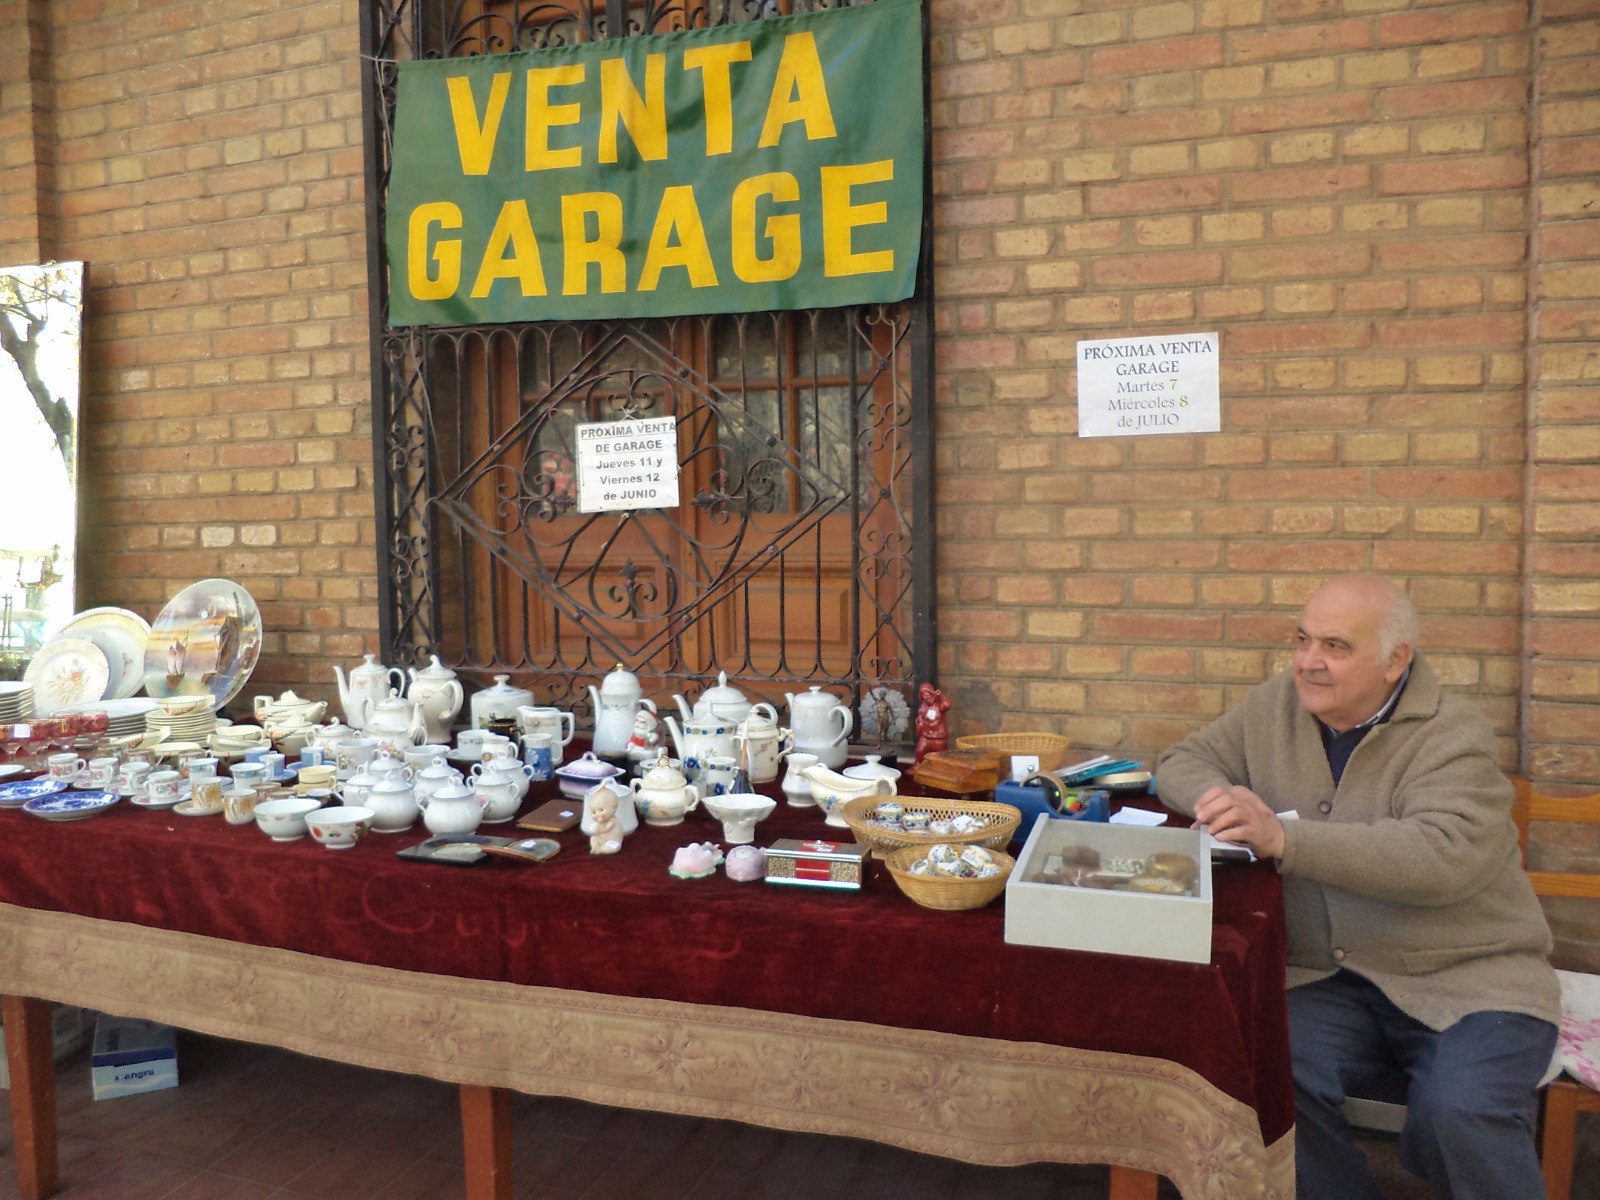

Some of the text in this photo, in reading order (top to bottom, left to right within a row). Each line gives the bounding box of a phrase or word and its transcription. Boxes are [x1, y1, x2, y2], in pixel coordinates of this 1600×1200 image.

[447, 31, 837, 176] VENTA
[408, 159, 894, 300] GARAGE
[1084, 340, 1212, 360] PRÓXIMA VENTA
[1116, 360, 1180, 376] GARAGE
[1117, 379, 1178, 393] Martes 7
[1108, 395, 1189, 411] Miércoles 8
[636, 422, 676, 434] VENTA
[1117, 413, 1180, 430] de JULIO
[595, 440, 663, 453] DE GARAGE
[596, 457, 663, 469] Jueves 11 y
[600, 473, 660, 485] Viernes 12
[603, 489, 657, 501] de JUNIO
